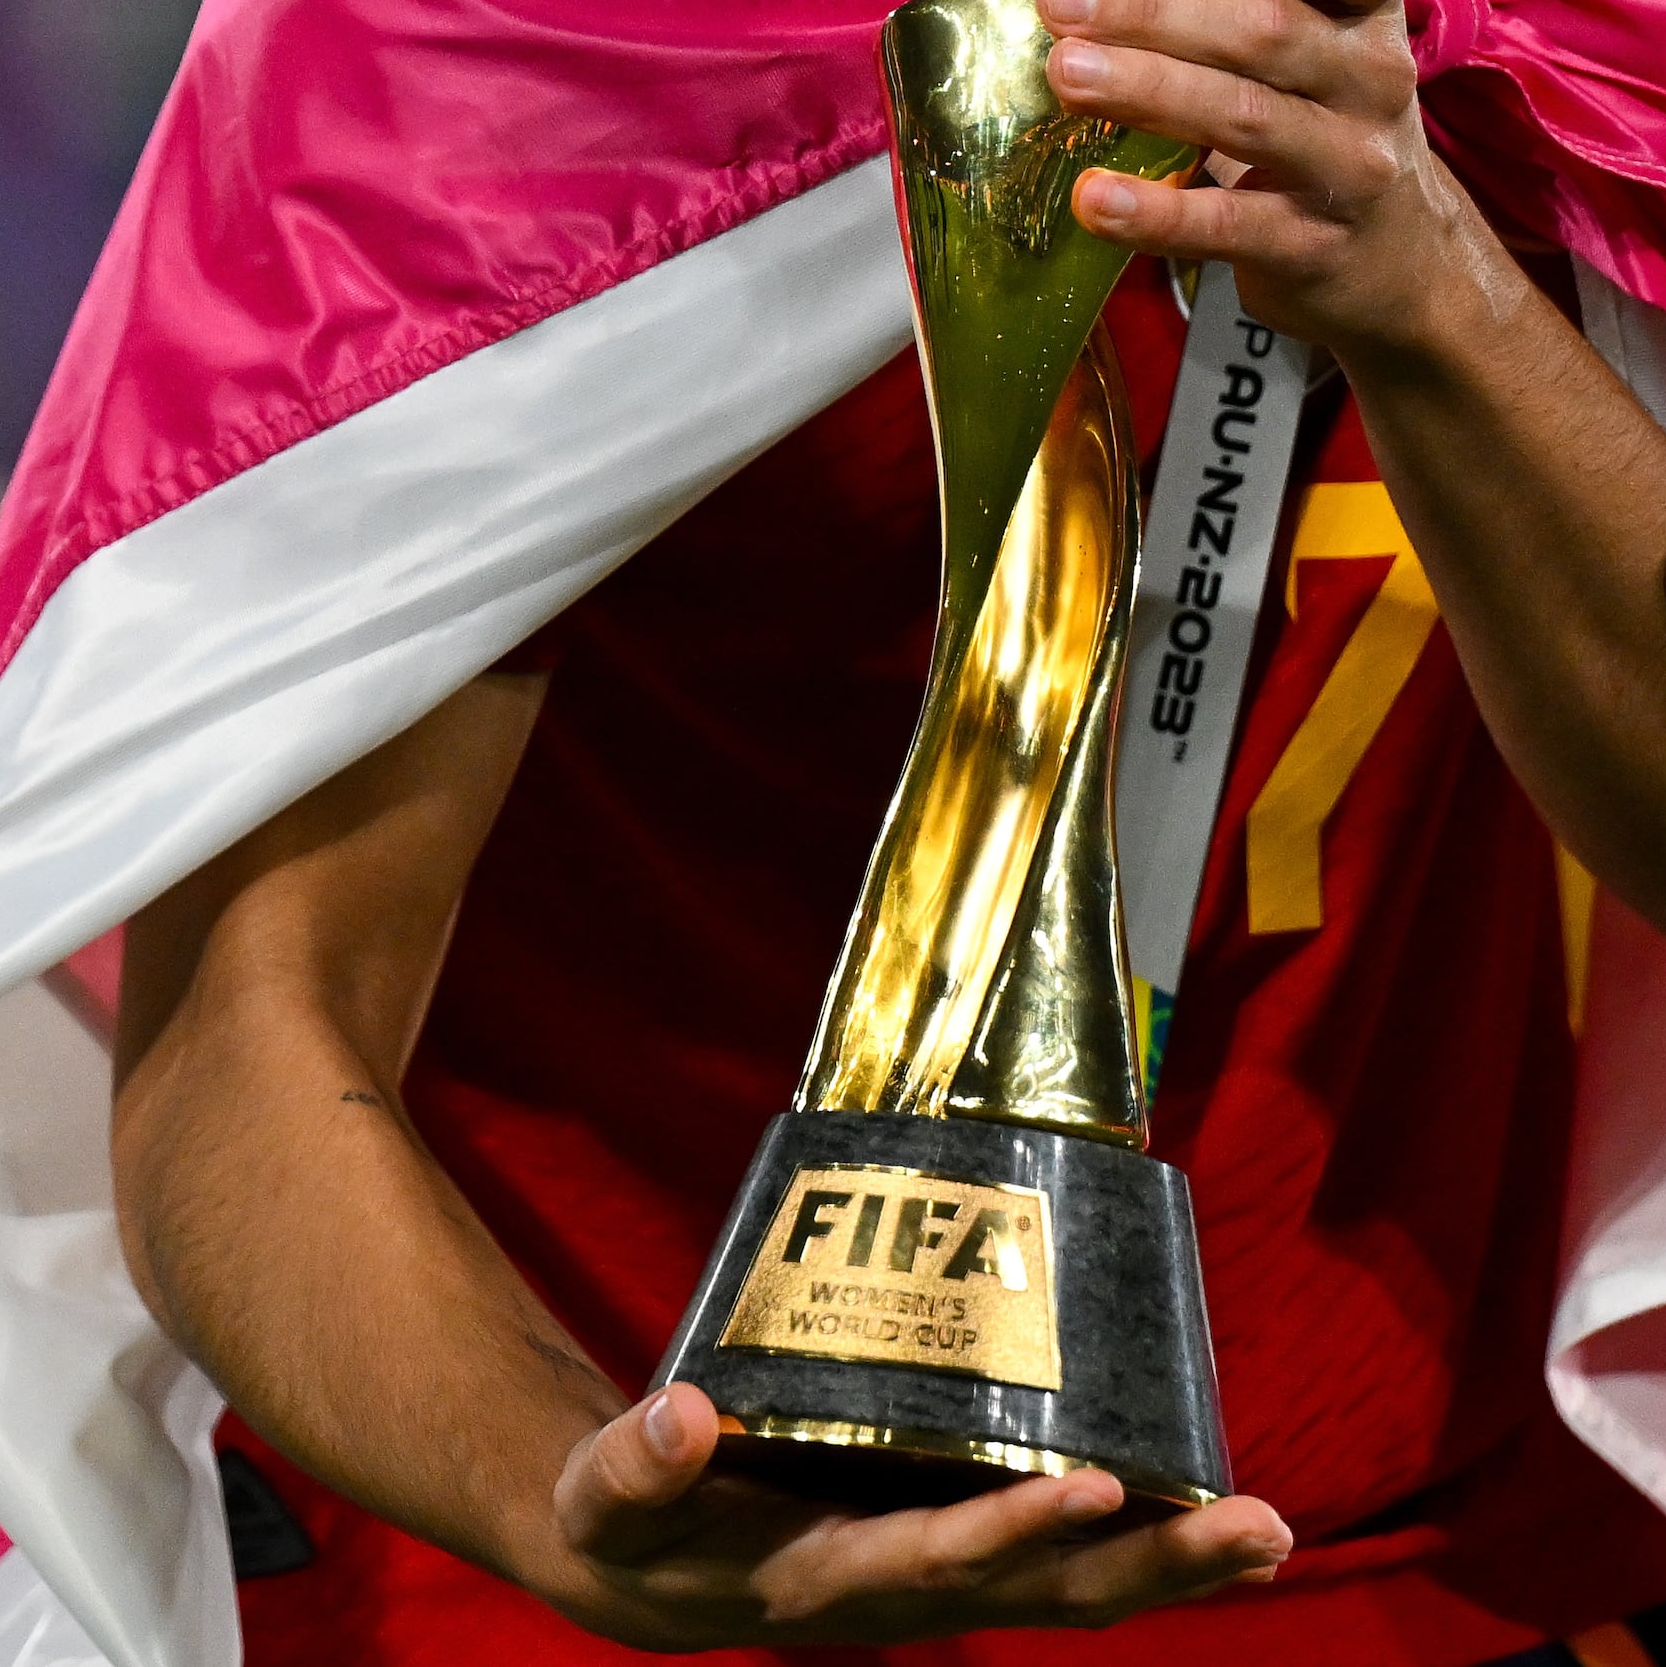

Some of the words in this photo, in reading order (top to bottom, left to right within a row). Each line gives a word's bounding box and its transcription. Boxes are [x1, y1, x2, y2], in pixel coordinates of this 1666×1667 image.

[809, 1280, 967, 1322] WOMEN'S
[788, 1308, 901, 1342] WORLD
[914, 1323, 979, 1352] CUP
